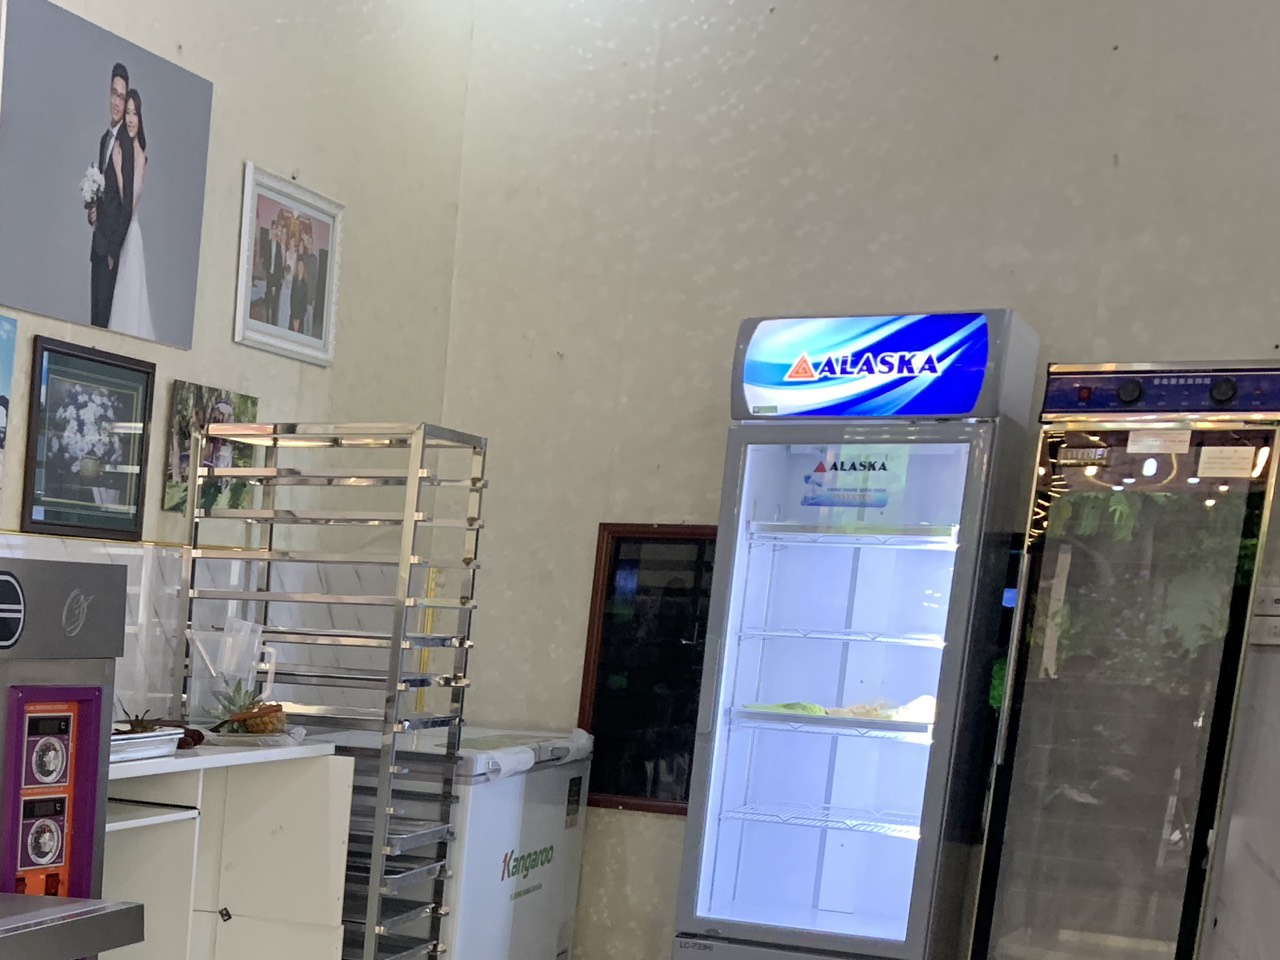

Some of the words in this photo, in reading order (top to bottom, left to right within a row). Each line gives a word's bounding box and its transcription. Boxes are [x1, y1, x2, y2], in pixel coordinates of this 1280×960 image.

[818, 353, 939, 376] ALASKA
[829, 460, 888, 472] ALASKA
[501, 845, 554, 881] Kangaroo
